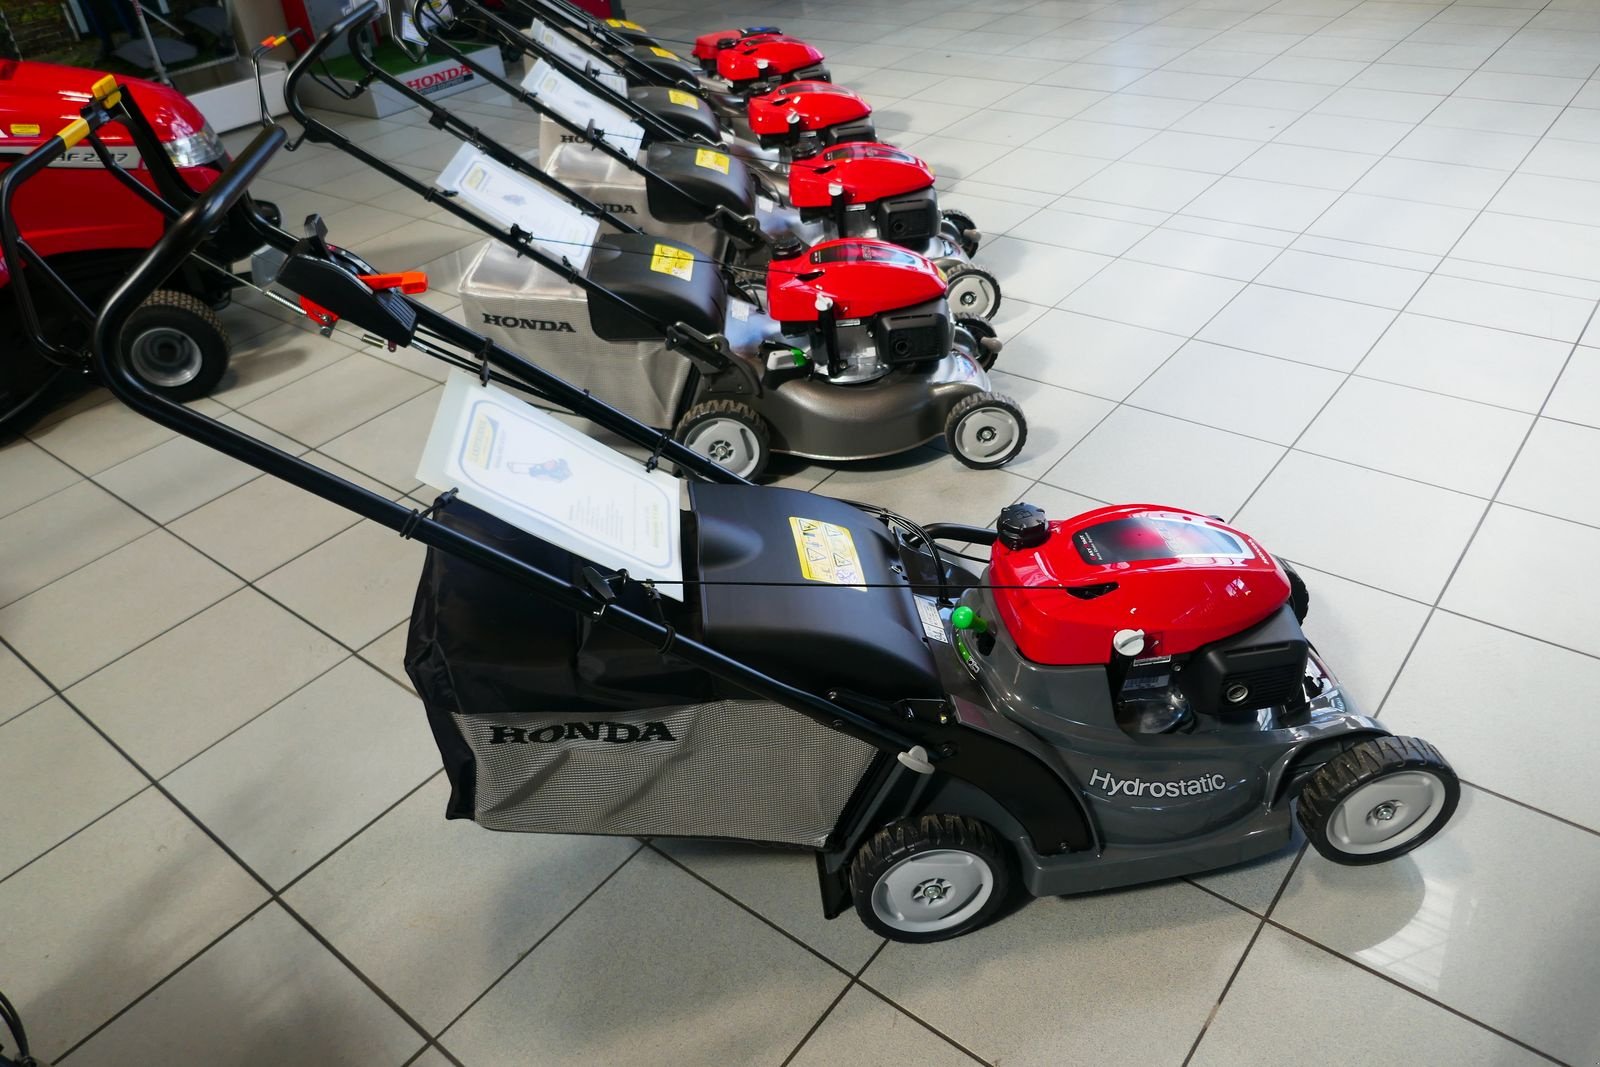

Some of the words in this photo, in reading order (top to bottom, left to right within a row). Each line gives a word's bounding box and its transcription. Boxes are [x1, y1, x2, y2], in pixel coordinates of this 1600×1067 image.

[407, 65, 473, 90] HONDA
[482, 313, 576, 333] HONDA
[489, 721, 676, 744] HONDA
[1089, 769, 1226, 798] Hydrostatic
